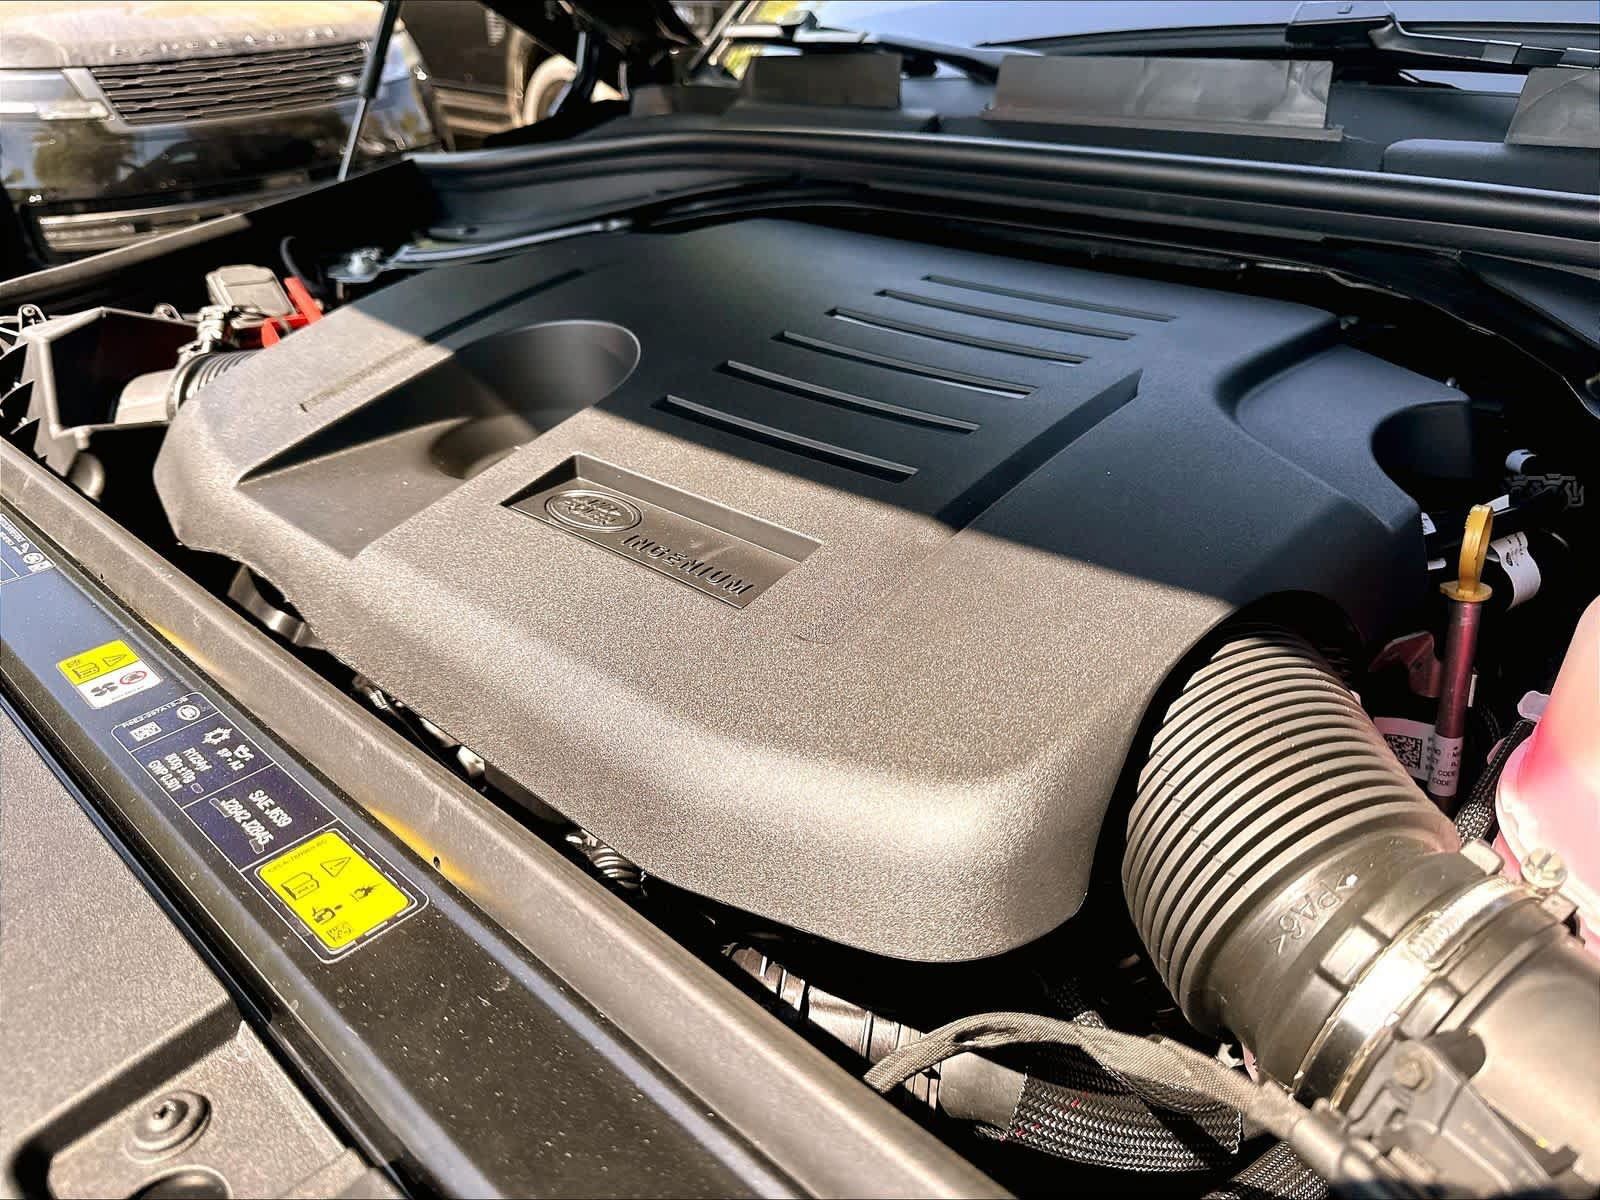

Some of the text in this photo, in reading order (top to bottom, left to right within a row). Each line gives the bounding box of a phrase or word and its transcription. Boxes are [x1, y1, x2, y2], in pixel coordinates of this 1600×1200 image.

[622, 534, 754, 596] INGENIUM
[248, 789, 293, 828] SAE J639
